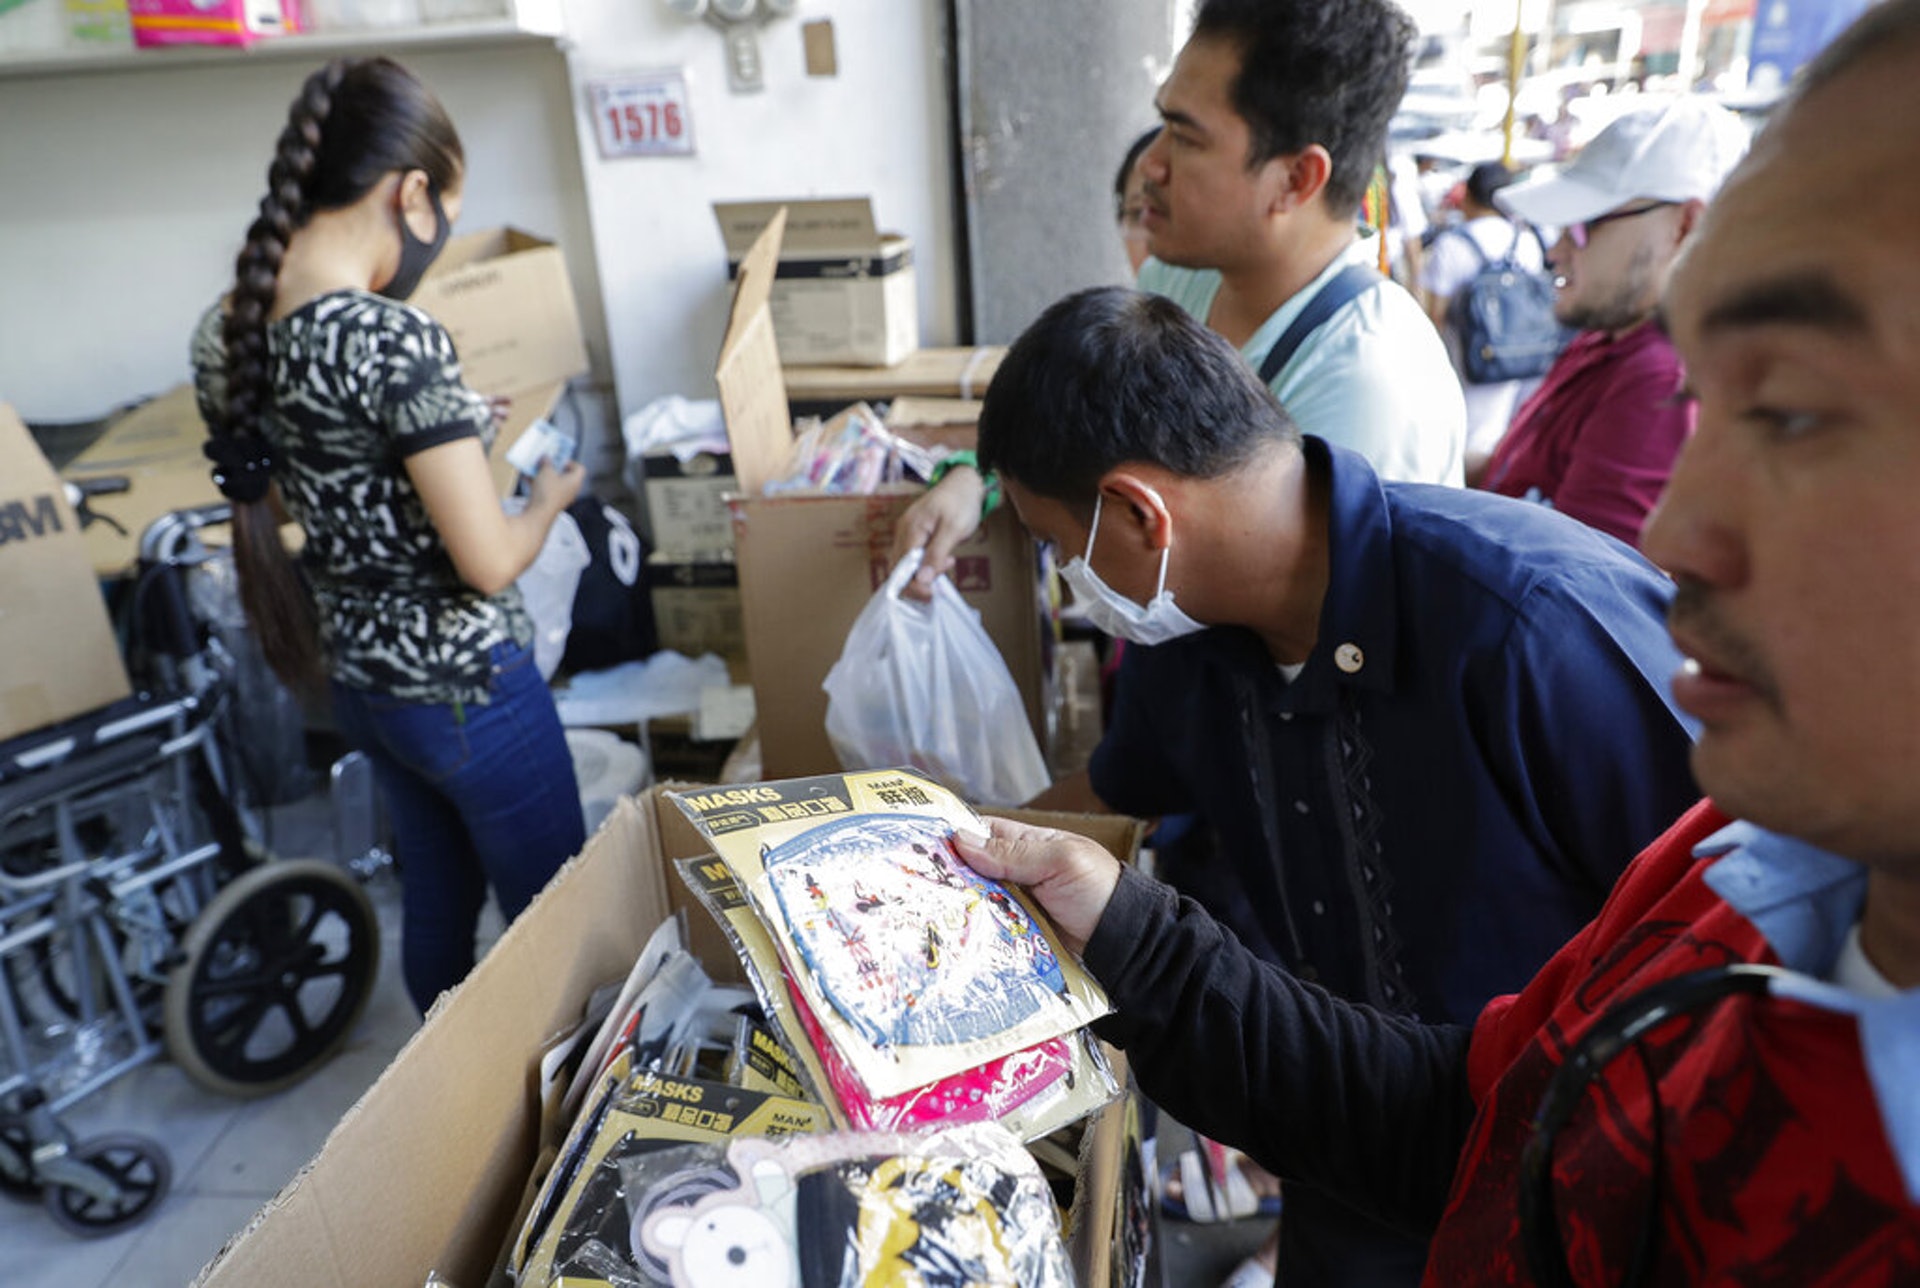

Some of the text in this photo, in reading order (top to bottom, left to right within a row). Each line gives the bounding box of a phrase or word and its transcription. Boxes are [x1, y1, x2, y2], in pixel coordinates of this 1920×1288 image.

[607, 100, 682, 142] 1576
[685, 786, 783, 812] MASKS
[632, 1074, 704, 1103] MASKS
